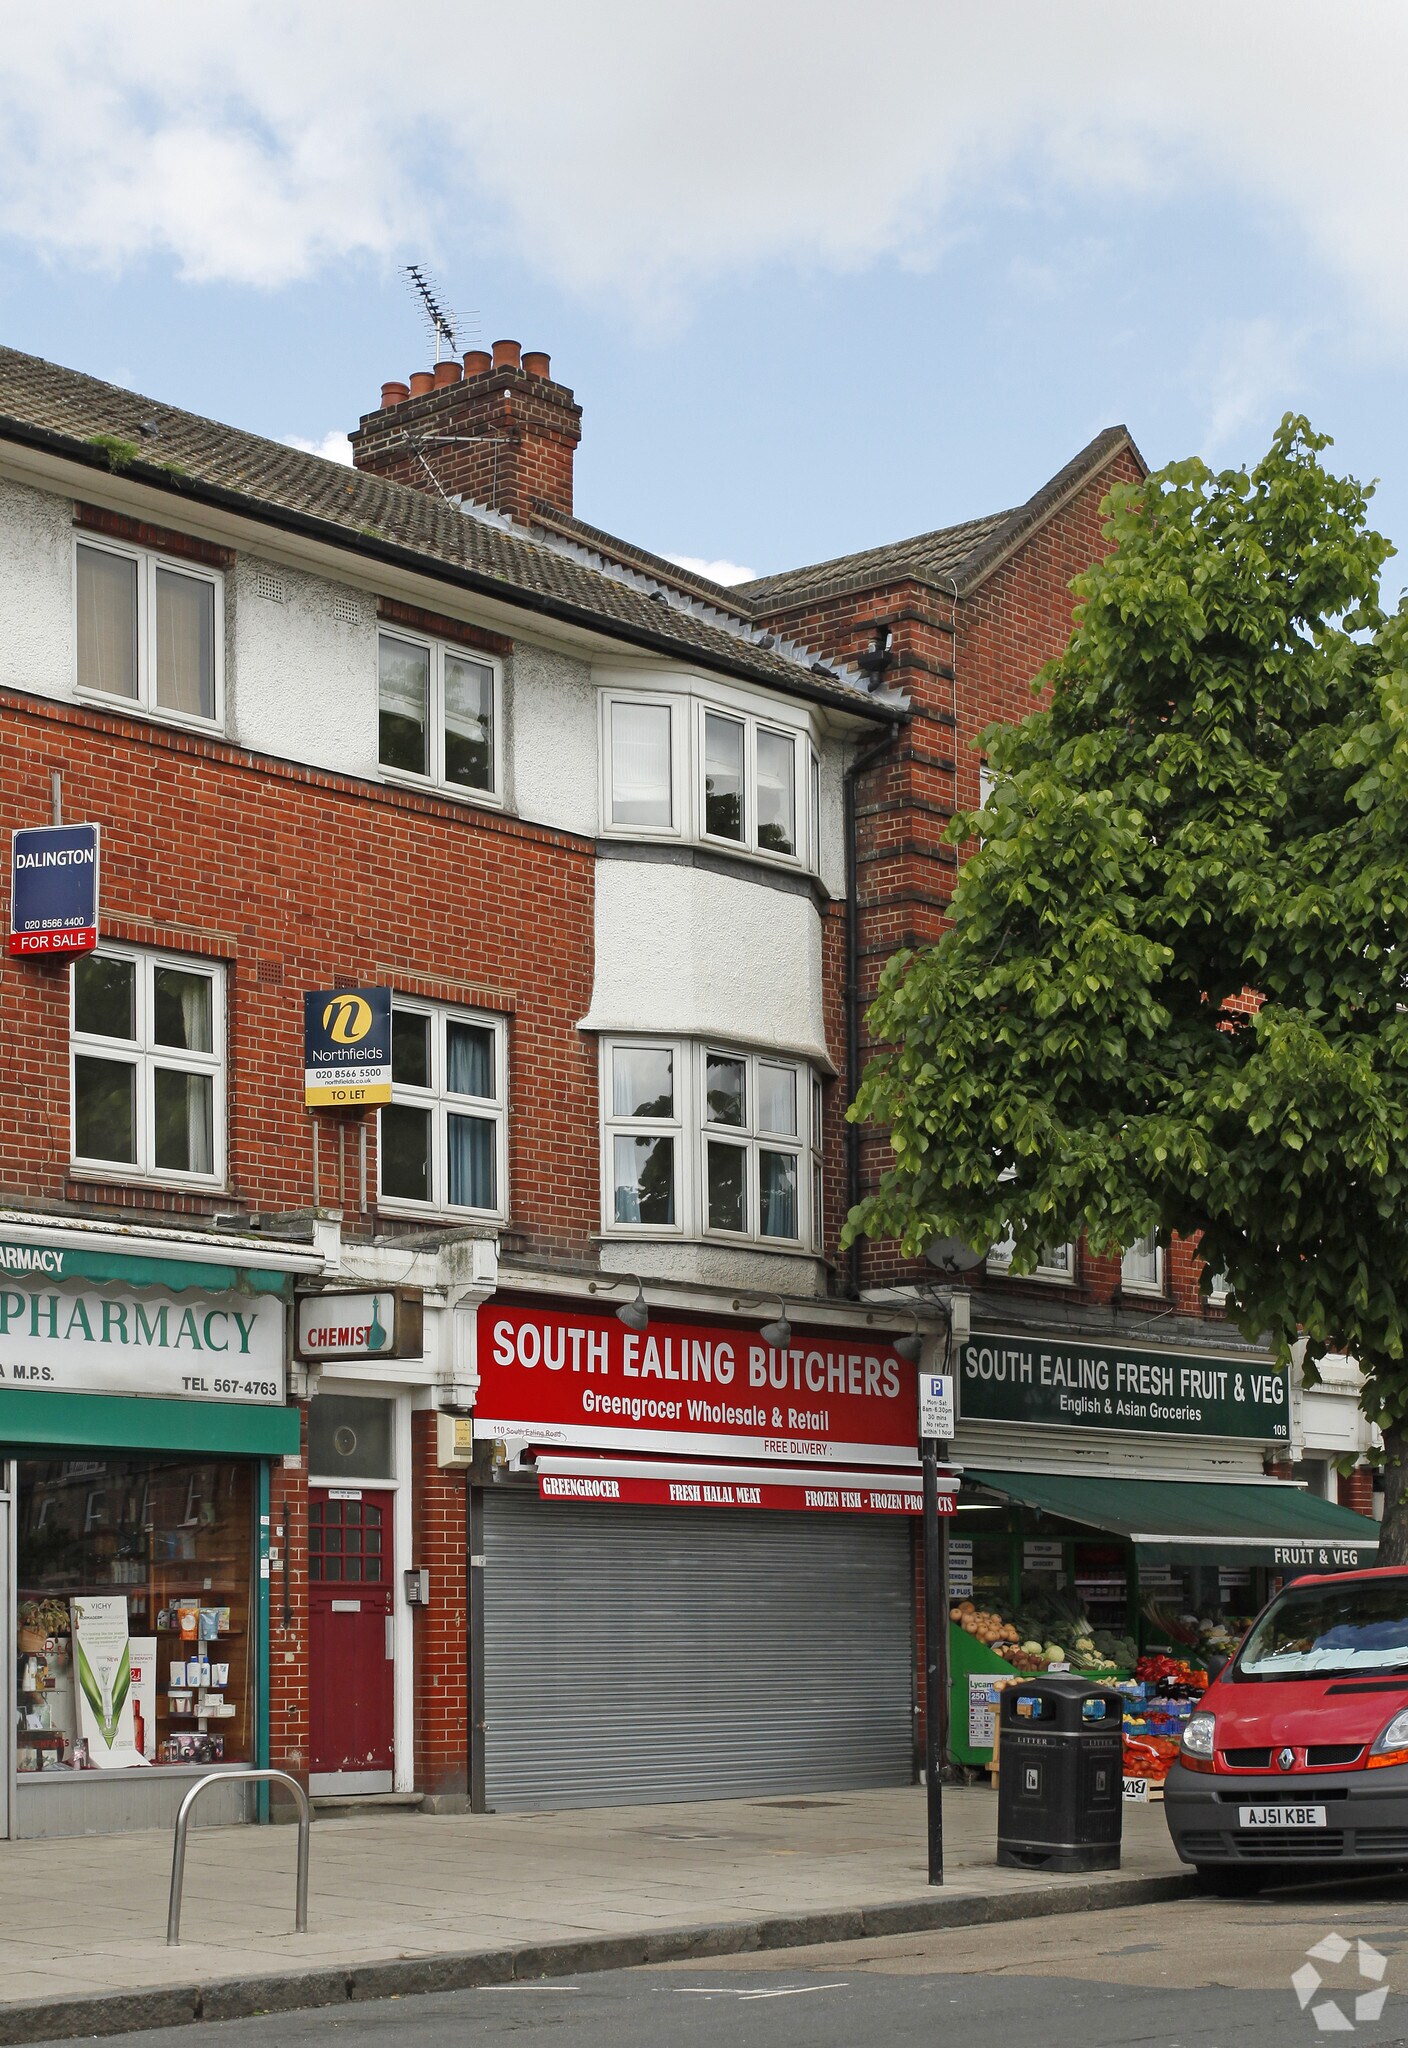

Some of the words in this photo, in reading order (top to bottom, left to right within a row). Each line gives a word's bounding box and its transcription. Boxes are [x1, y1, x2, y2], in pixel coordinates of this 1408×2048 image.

[16, 848, 94, 869] DALINGTON
[25, 920, 40, 930] 020
[42, 918, 62, 928] 8566
[64, 916, 84, 926] 4400
[21, 936, 49, 949] FOR
[52, 932, 86, 947] SALE
[312, 1047, 383, 1062] Northfields
[315, 1070, 332, 1079] 020
[335, 1069, 357, 1078] 8566
[360, 1068, 381, 1077] 5500
[324, 1078, 372, 1086] northfields.co.uk
[332, 1091, 346, 1100] TO
[350, 1090, 366, 1100] LET
[0, 1291, 259, 1355] PHARMACY
[307, 1325, 372, 1348] CHEMIST
[492, 1320, 609, 1375] SOUTH
[623, 1333, 735, 1385] EALING
[749, 1346, 900, 1398] BUTCHERS
[13, 1365, 54, 1381] M.P.S.
[965, 1347, 1032, 1383] SOUTH
[1040, 1354, 1109, 1391] EALING
[1116, 1362, 1174, 1397] FRESH
[1180, 1368, 1228, 1400] FRUIT
[1233, 1373, 1246, 1402] &
[1250, 1374, 1284, 1405] VEG
[182, 1376, 208, 1391] TEL
[213, 1379, 277, 1396] 567-4763
[933, 1380, 941, 1395] P
[582, 1389, 682, 1421] Greengrocer
[687, 1399, 767, 1427] Wholesale
[772, 1406, 783, 1428] &
[788, 1408, 829, 1431] Retail
[1060, 1394, 1101, 1416] English
[1104, 1398, 1113, 1414] &
[1116, 1400, 1147, 1417] Asian
[1149, 1402, 1202, 1421] Groceries
[493, 1425, 505, 1434] 110
[506, 1427, 524, 1436] South
[525, 1428, 545, 1438] Ealing
[545, 1430, 561, 1438] Road
[1273, 1424, 1287, 1436] 108
[764, 1440, 788, 1454] FREE
[790, 1441, 827, 1456] DLIVERY
[542, 1477, 620, 1498] GREENGROCER
[669, 1484, 701, 1501] FRESH
[703, 1485, 735, 1503] HALAL
[736, 1487, 761, 1504] MEAT
[805, 1490, 839, 1507] FROZEN
[841, 1492, 862, 1508] FISH
[869, 1493, 902, 1509] FROZEN
[904, 1494, 953, 1512] PROCTS
[1274, 1547, 1314, 1564] FRUIT
[1319, 1549, 1329, 1565] &
[1332, 1549, 1358, 1565] VEG
[971, 1692, 985, 1700] 250
[1017, 1737, 1047, 1745] LITTER
[1249, 1808, 1282, 1825] AJ51
[1286, 1808, 1316, 1824] KBE
